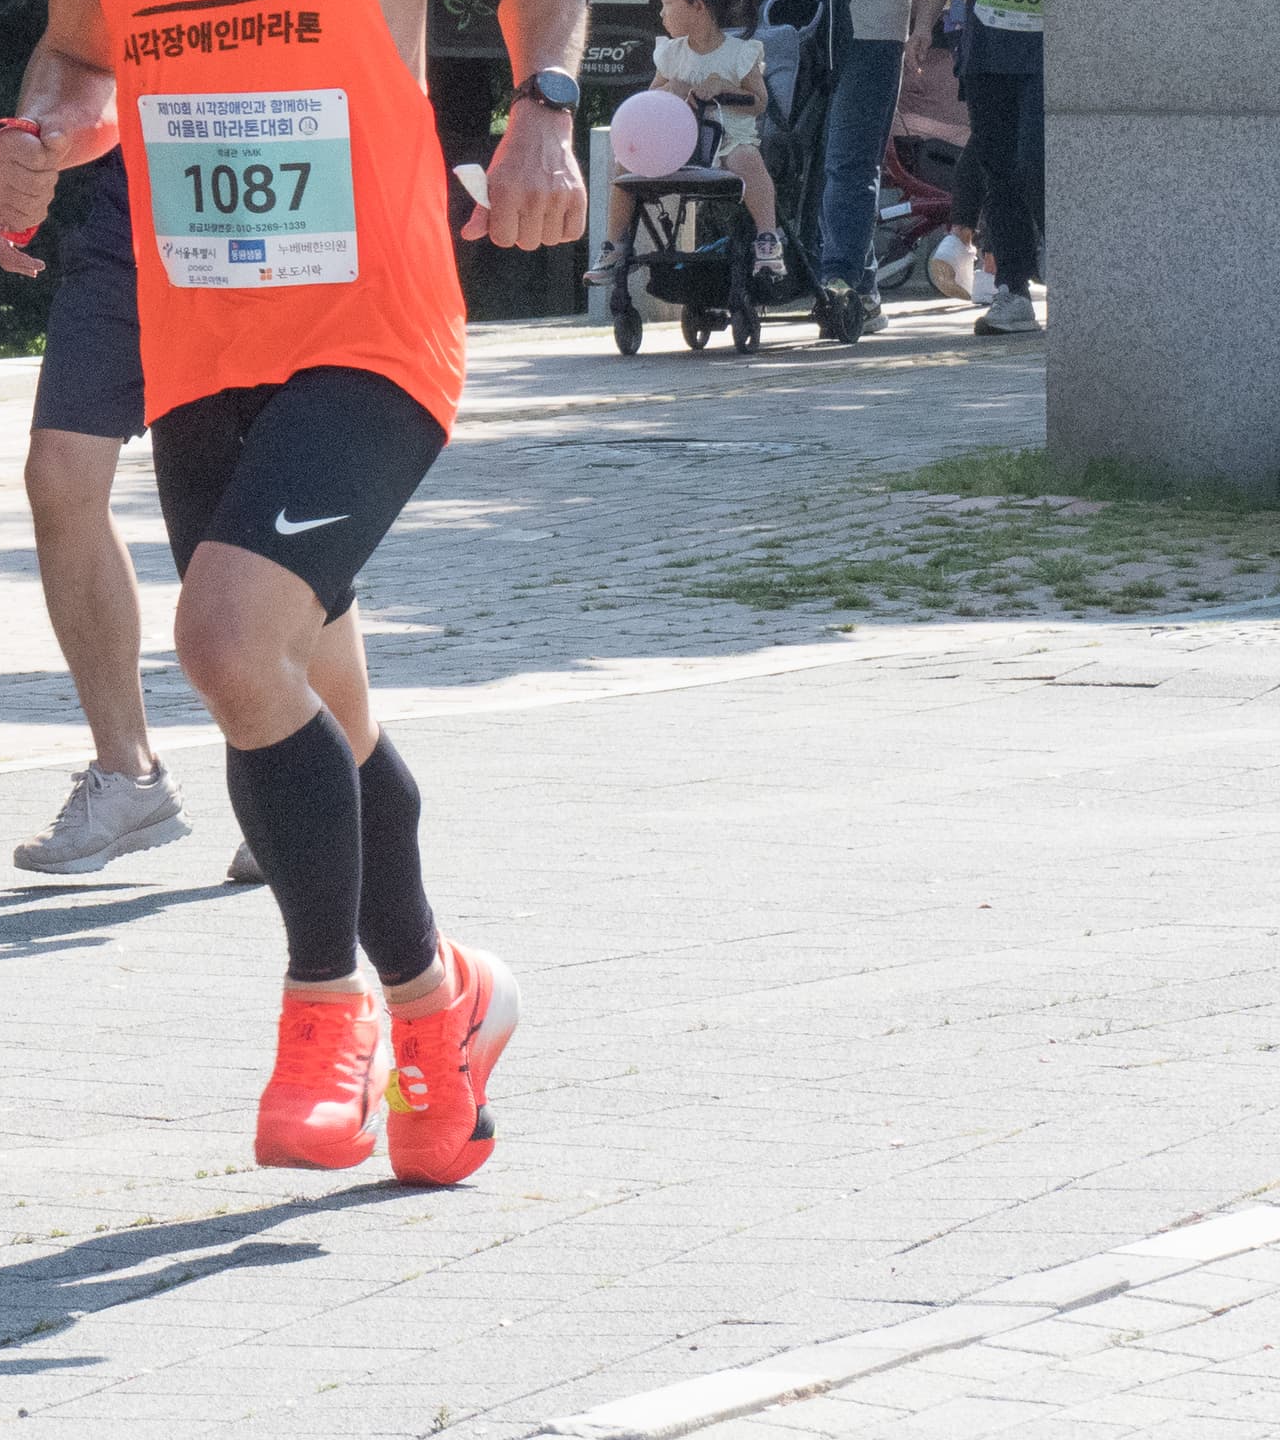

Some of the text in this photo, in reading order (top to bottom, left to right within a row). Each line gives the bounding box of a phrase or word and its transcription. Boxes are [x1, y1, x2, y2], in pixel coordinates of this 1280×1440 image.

[124, 10, 322, 66] 시각장애인마라톤
[586, 47, 625, 61] SPO
[157, 98, 322, 116] 제10회 시각장애인과 함께하는
[167, 118, 293, 138] 어울림 마라톤대회
[184, 162, 311, 214] 1087
[278, 239, 347, 254] 누베베한의원
